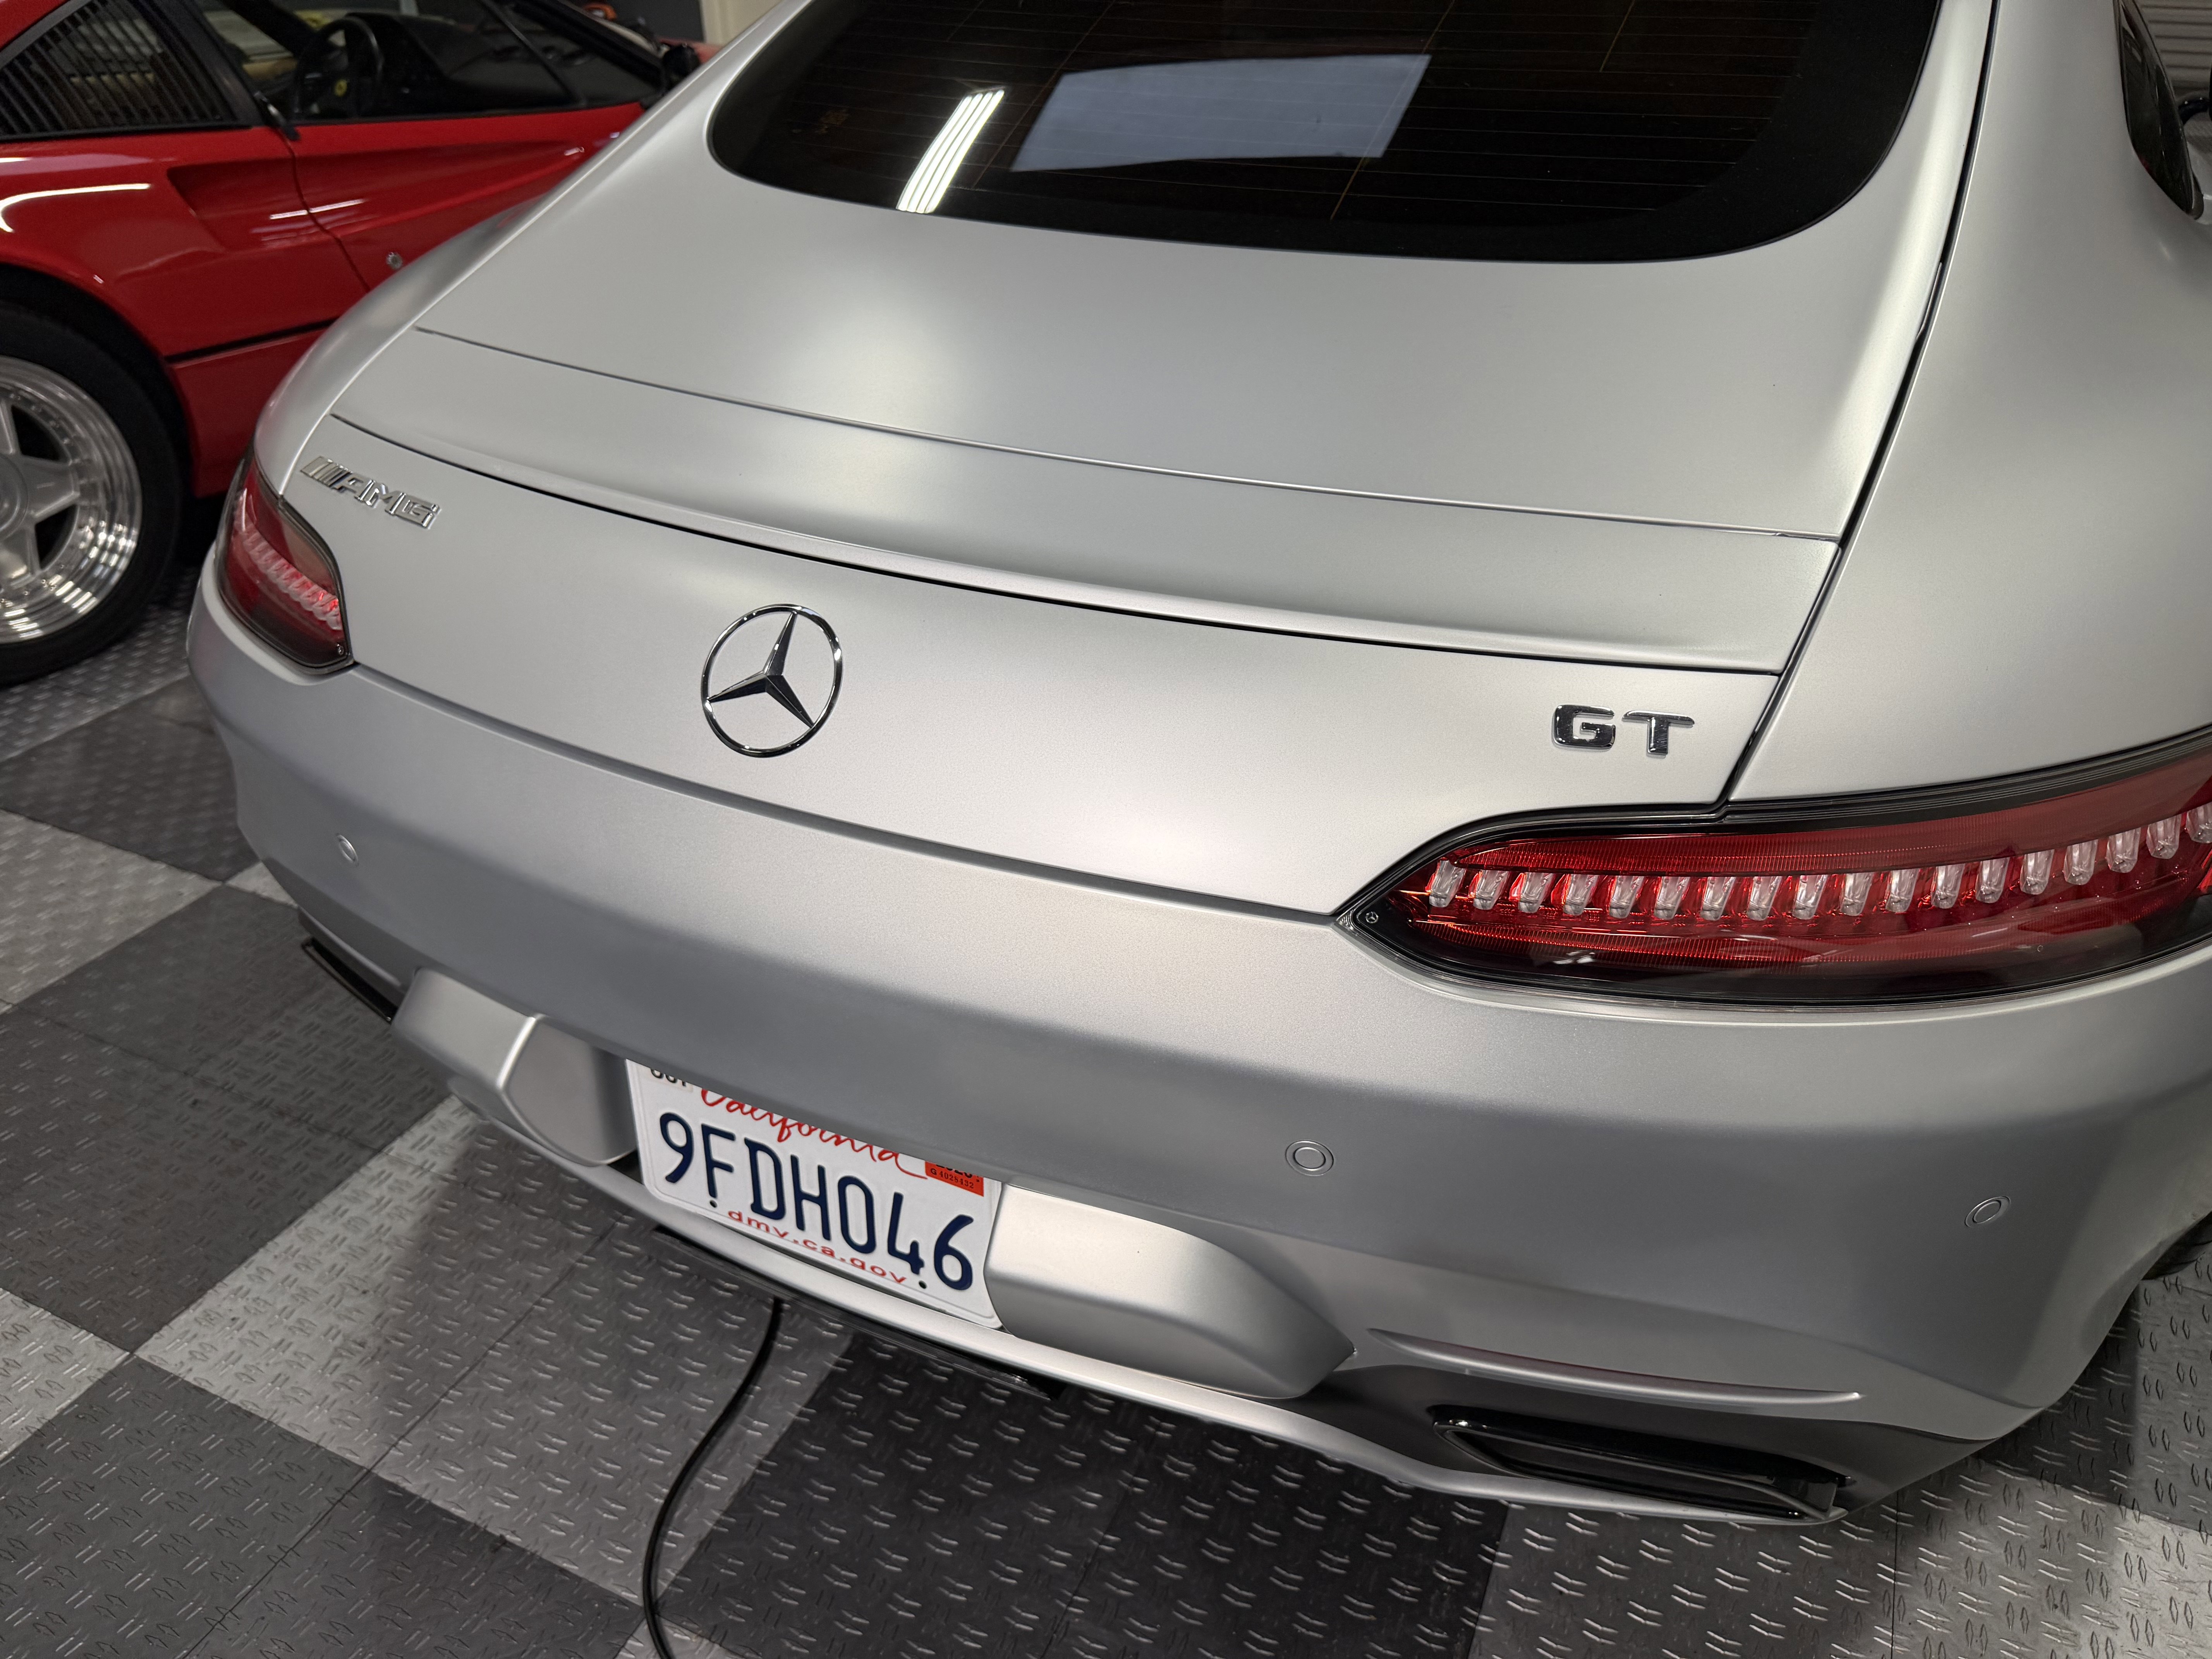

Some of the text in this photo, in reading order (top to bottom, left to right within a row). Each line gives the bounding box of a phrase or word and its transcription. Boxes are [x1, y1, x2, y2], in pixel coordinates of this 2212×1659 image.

[332, 470, 442, 529] AMG
[1551, 704, 1695, 759] GT
[659, 1112, 974, 1291] 9FDH046
[728, 1210, 907, 1284] dmv.ca.gov
